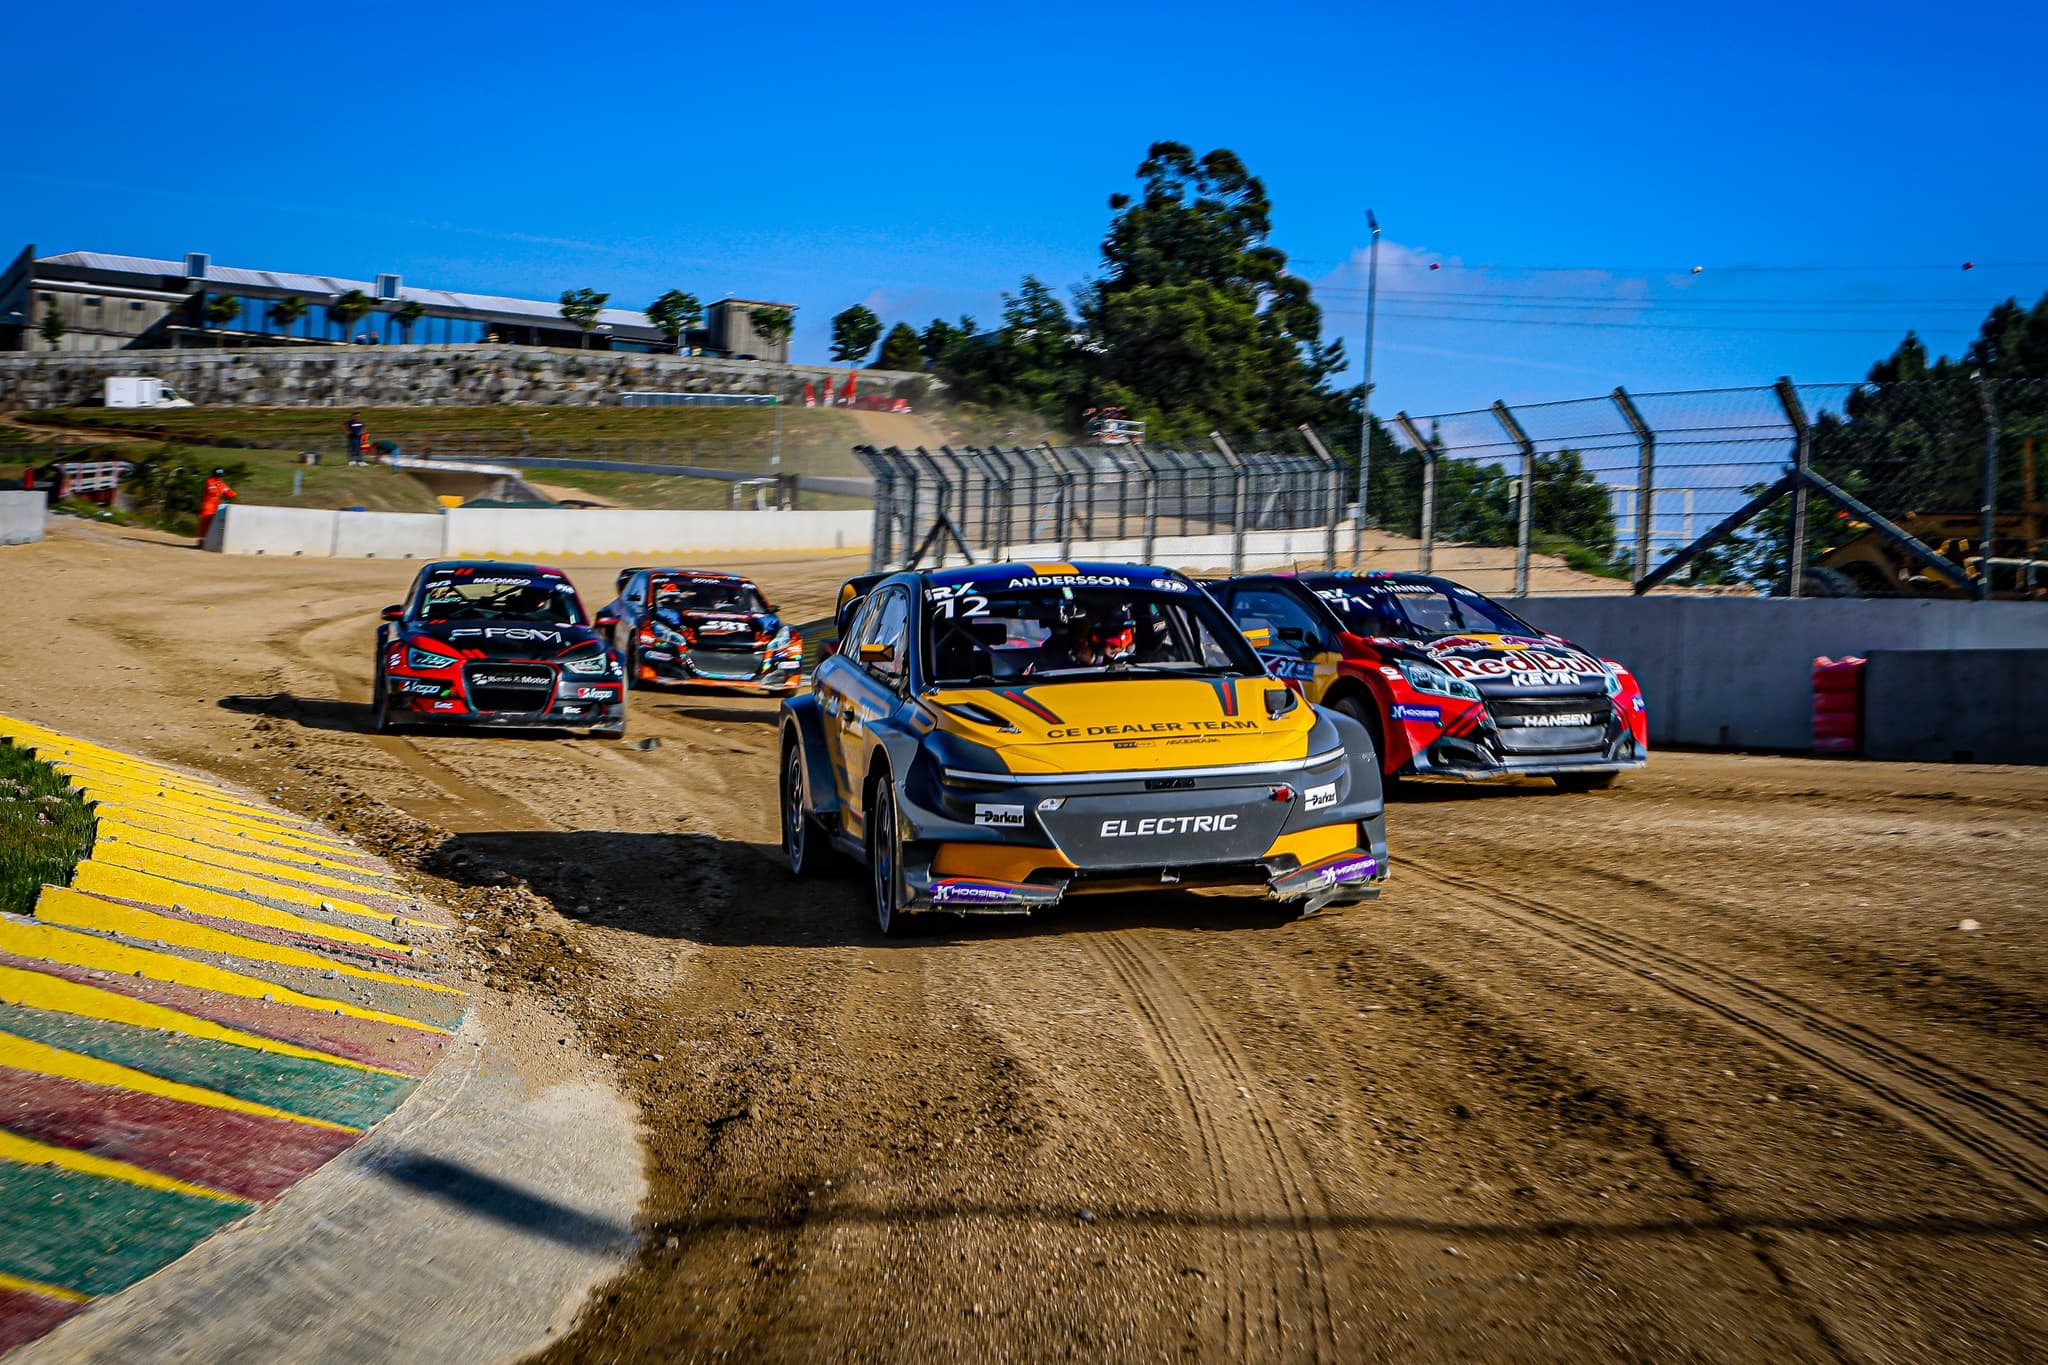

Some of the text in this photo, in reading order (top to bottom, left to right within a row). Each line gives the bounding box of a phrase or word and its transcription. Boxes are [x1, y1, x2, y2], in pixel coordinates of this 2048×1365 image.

[473, 577, 531, 585] MACHADO
[1008, 576, 1130, 588] ANDERSSON
[1387, 584, 1435, 593] HANSEN
[936, 596, 990, 618] 12
[1437, 650, 1606, 679] Red Bull
[1511, 672, 1580, 687] KEVIN
[1403, 708, 1440, 719] HOOSIER
[1523, 713, 1592, 727] HANSEN
[1047, 720, 1259, 738] CE DEALER TEAM
[1312, 792, 1335, 806] Parker
[983, 811, 1024, 824] Parker
[1100, 814, 1239, 837] ELECTRIC
[951, 887, 1006, 900] HOOSIER
